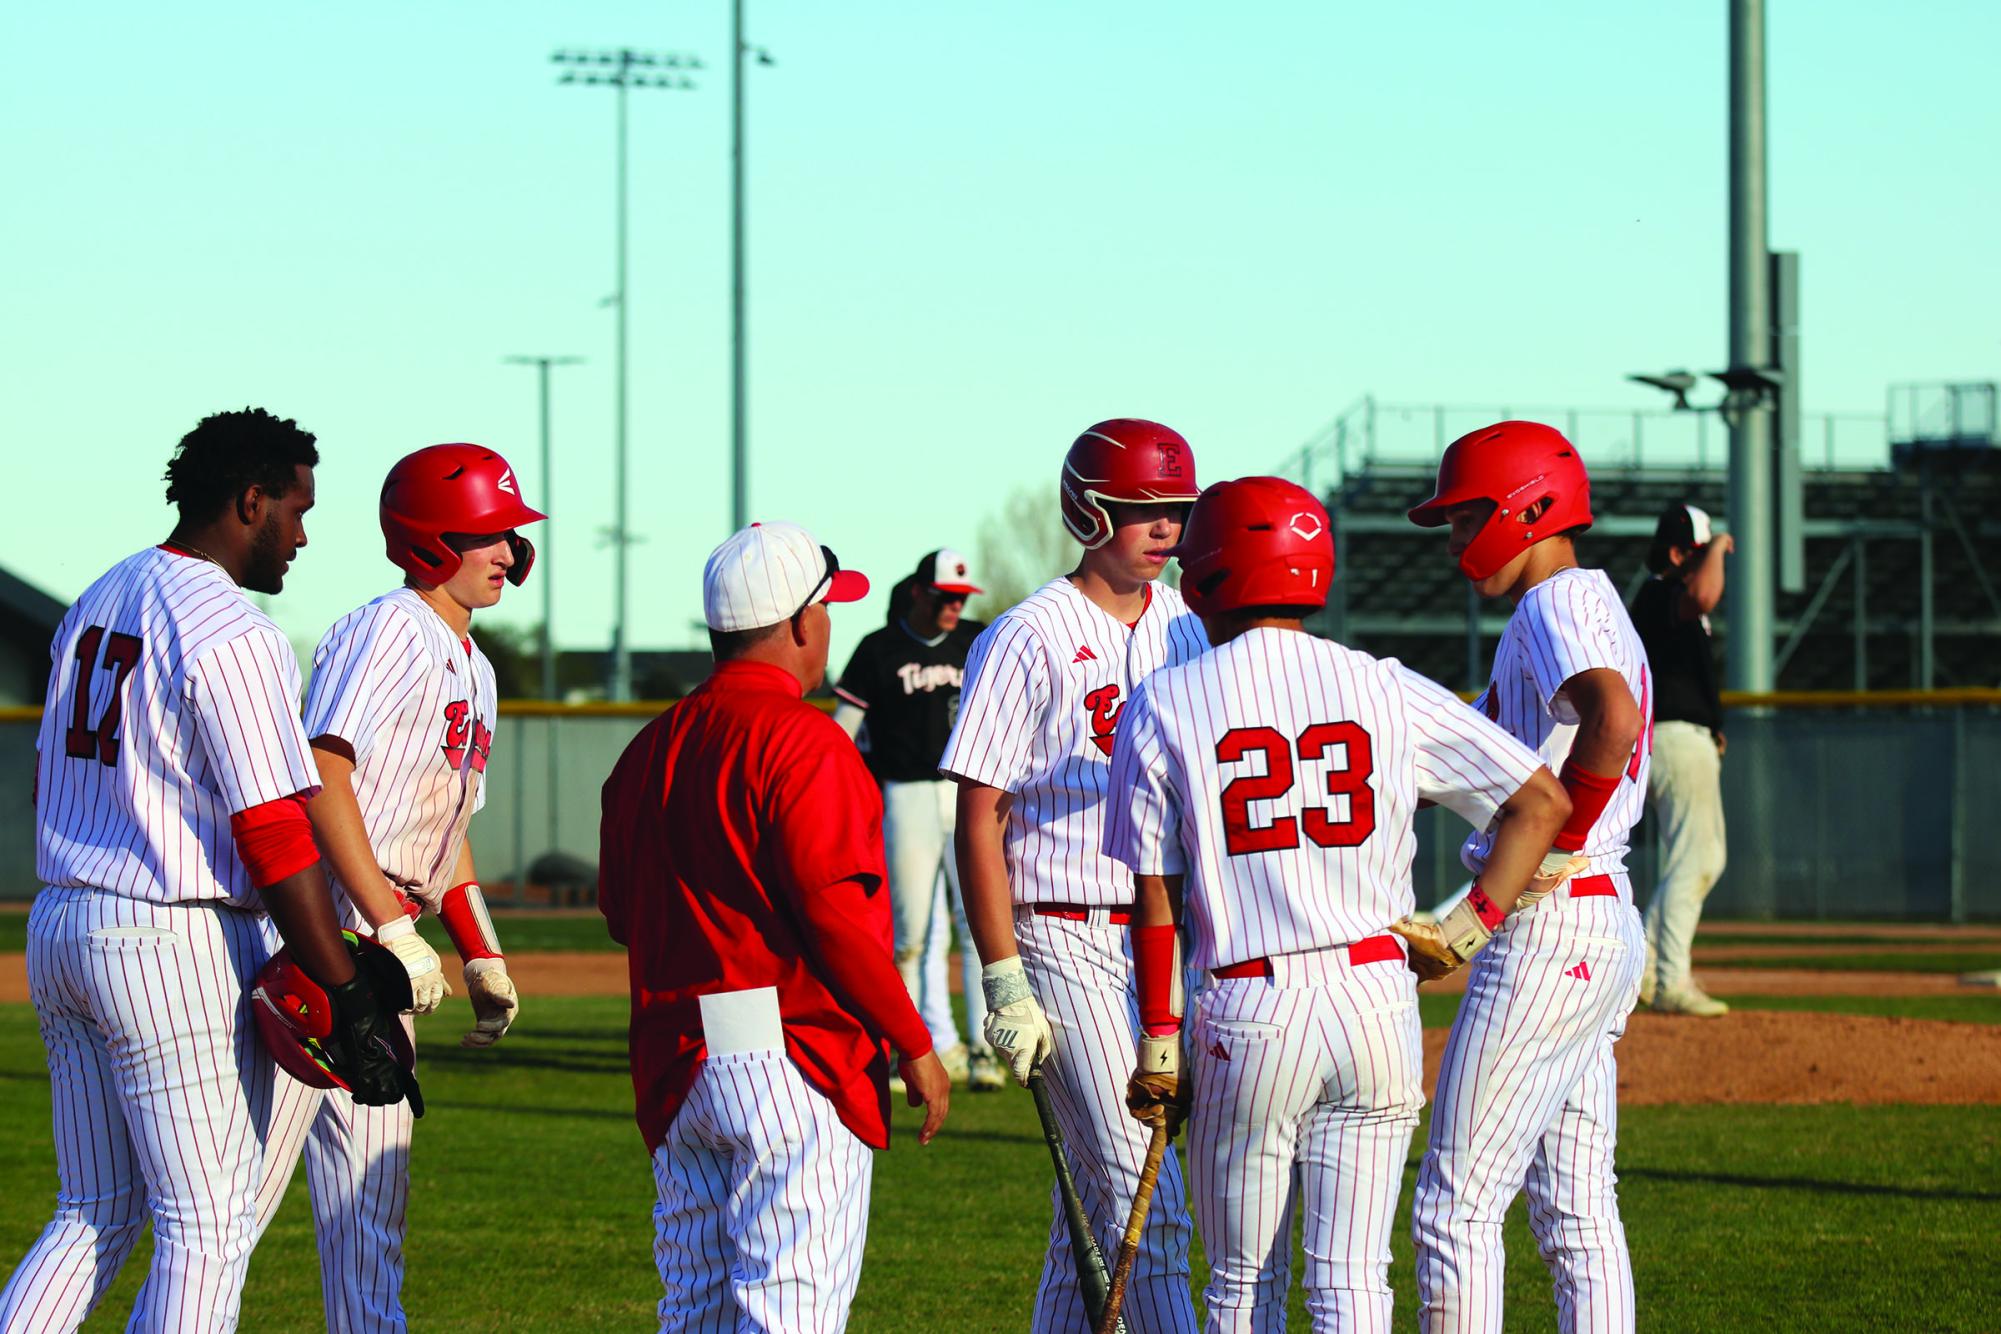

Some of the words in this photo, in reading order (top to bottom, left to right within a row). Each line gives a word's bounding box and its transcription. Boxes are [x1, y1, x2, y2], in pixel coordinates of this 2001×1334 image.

[1157, 442, 1182, 478] E
[65, 624, 144, 768] 17
[1215, 720, 1376, 857] 23
